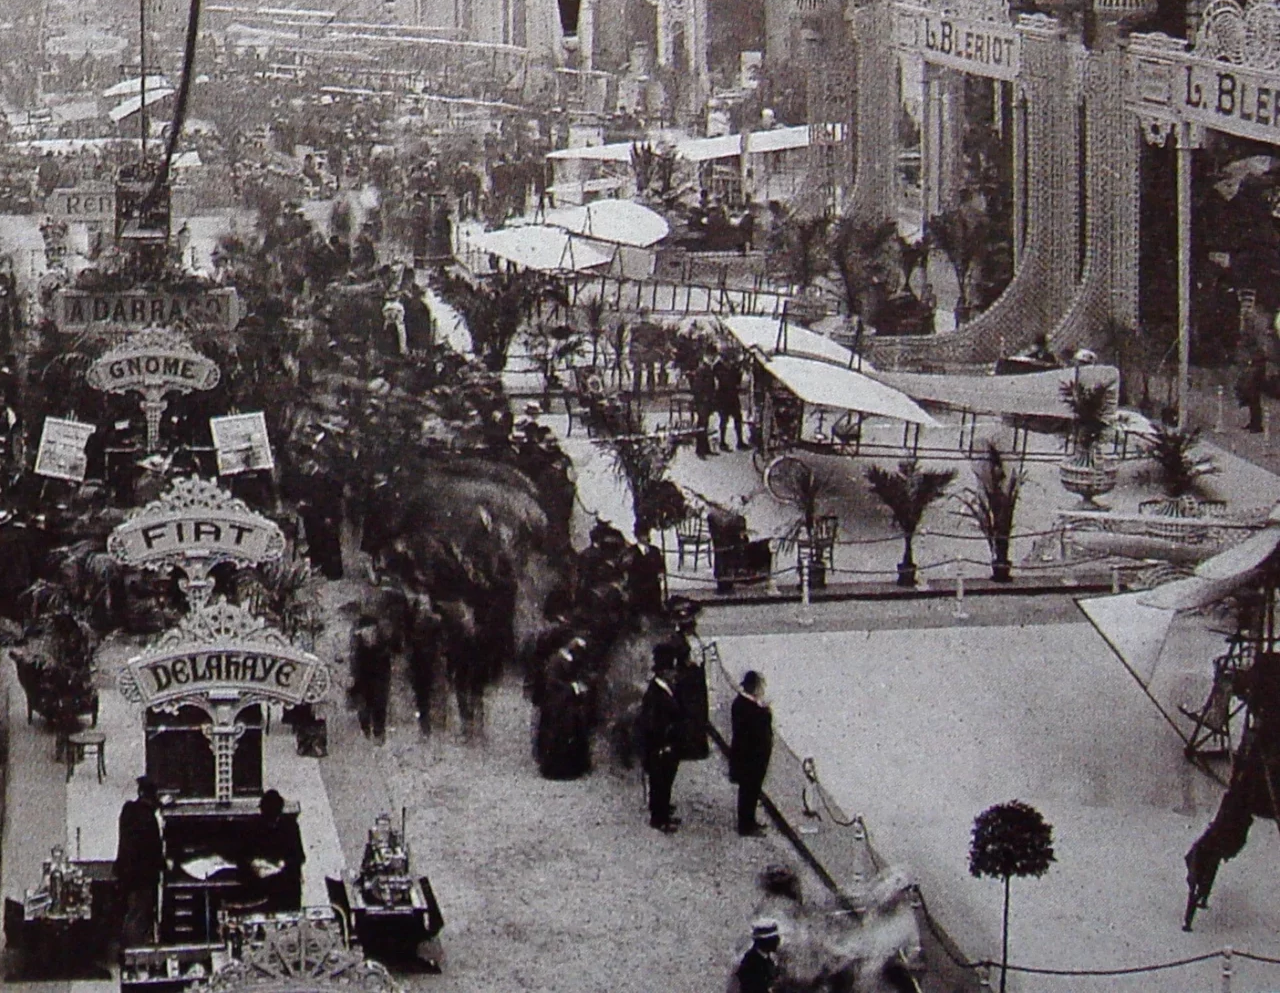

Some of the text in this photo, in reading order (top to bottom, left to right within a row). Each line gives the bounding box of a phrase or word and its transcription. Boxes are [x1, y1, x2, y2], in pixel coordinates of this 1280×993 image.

[109, 356, 196, 380] GNOME
[141, 521, 254, 549] FIAT
[149, 656, 297, 692] DELAHAYE
